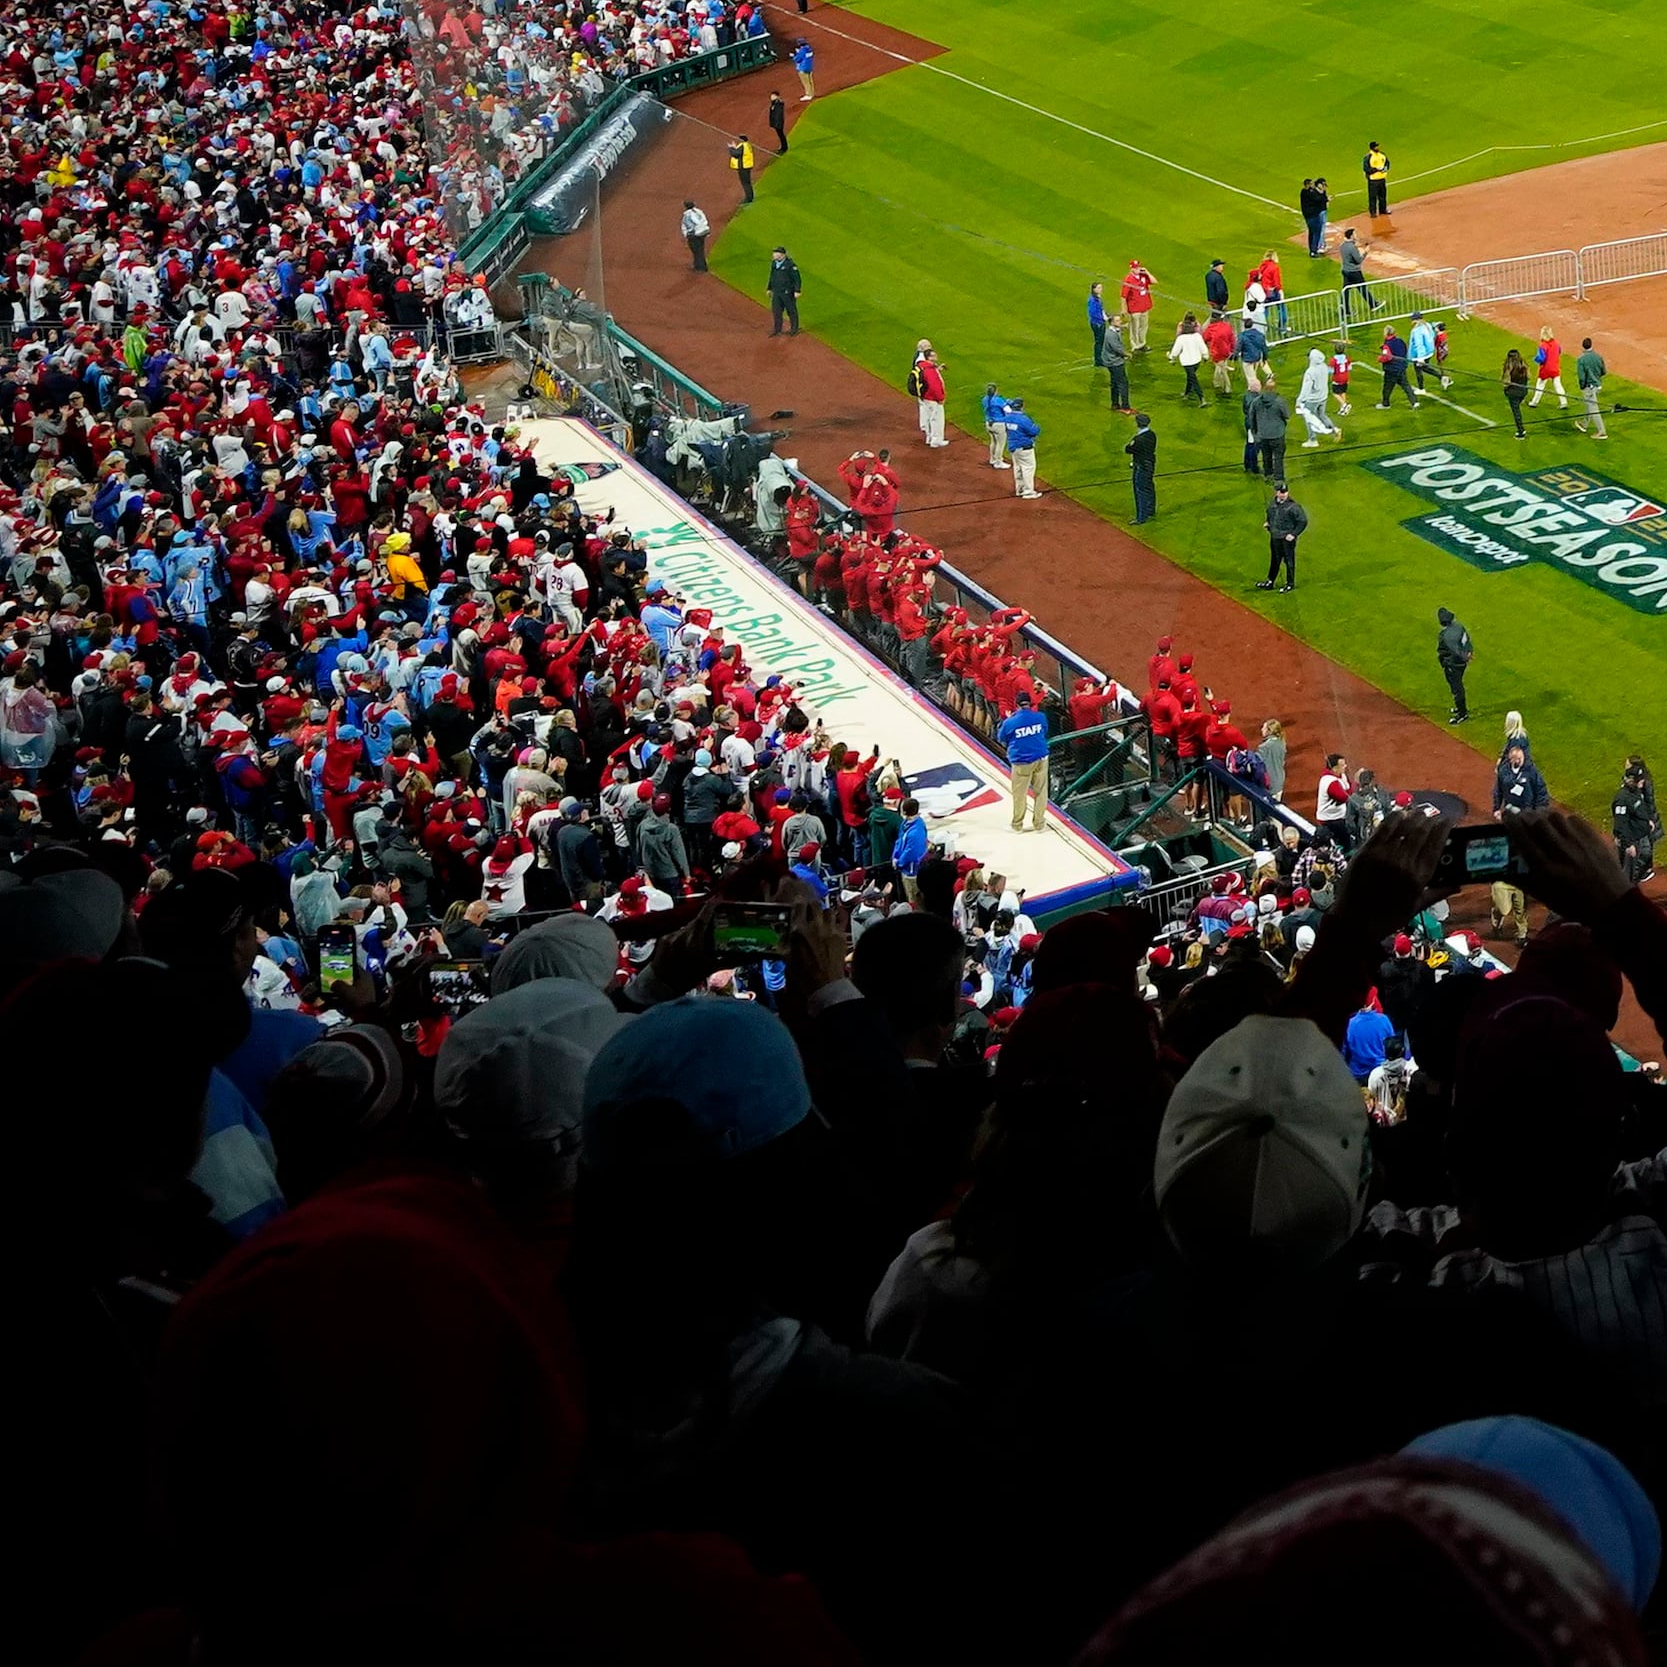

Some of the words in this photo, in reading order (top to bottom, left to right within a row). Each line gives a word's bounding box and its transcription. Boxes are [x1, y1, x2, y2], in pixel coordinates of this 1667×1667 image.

[222, 302, 229, 313] 3
[1538, 472, 1590, 493] 20
[1425, 514, 1528, 564] loanDepot
[655, 552, 755, 618] Citizens
[724, 613, 820, 665] Bank
[776, 658, 869, 708] Park
[1014, 723, 1042, 738] STAFF
